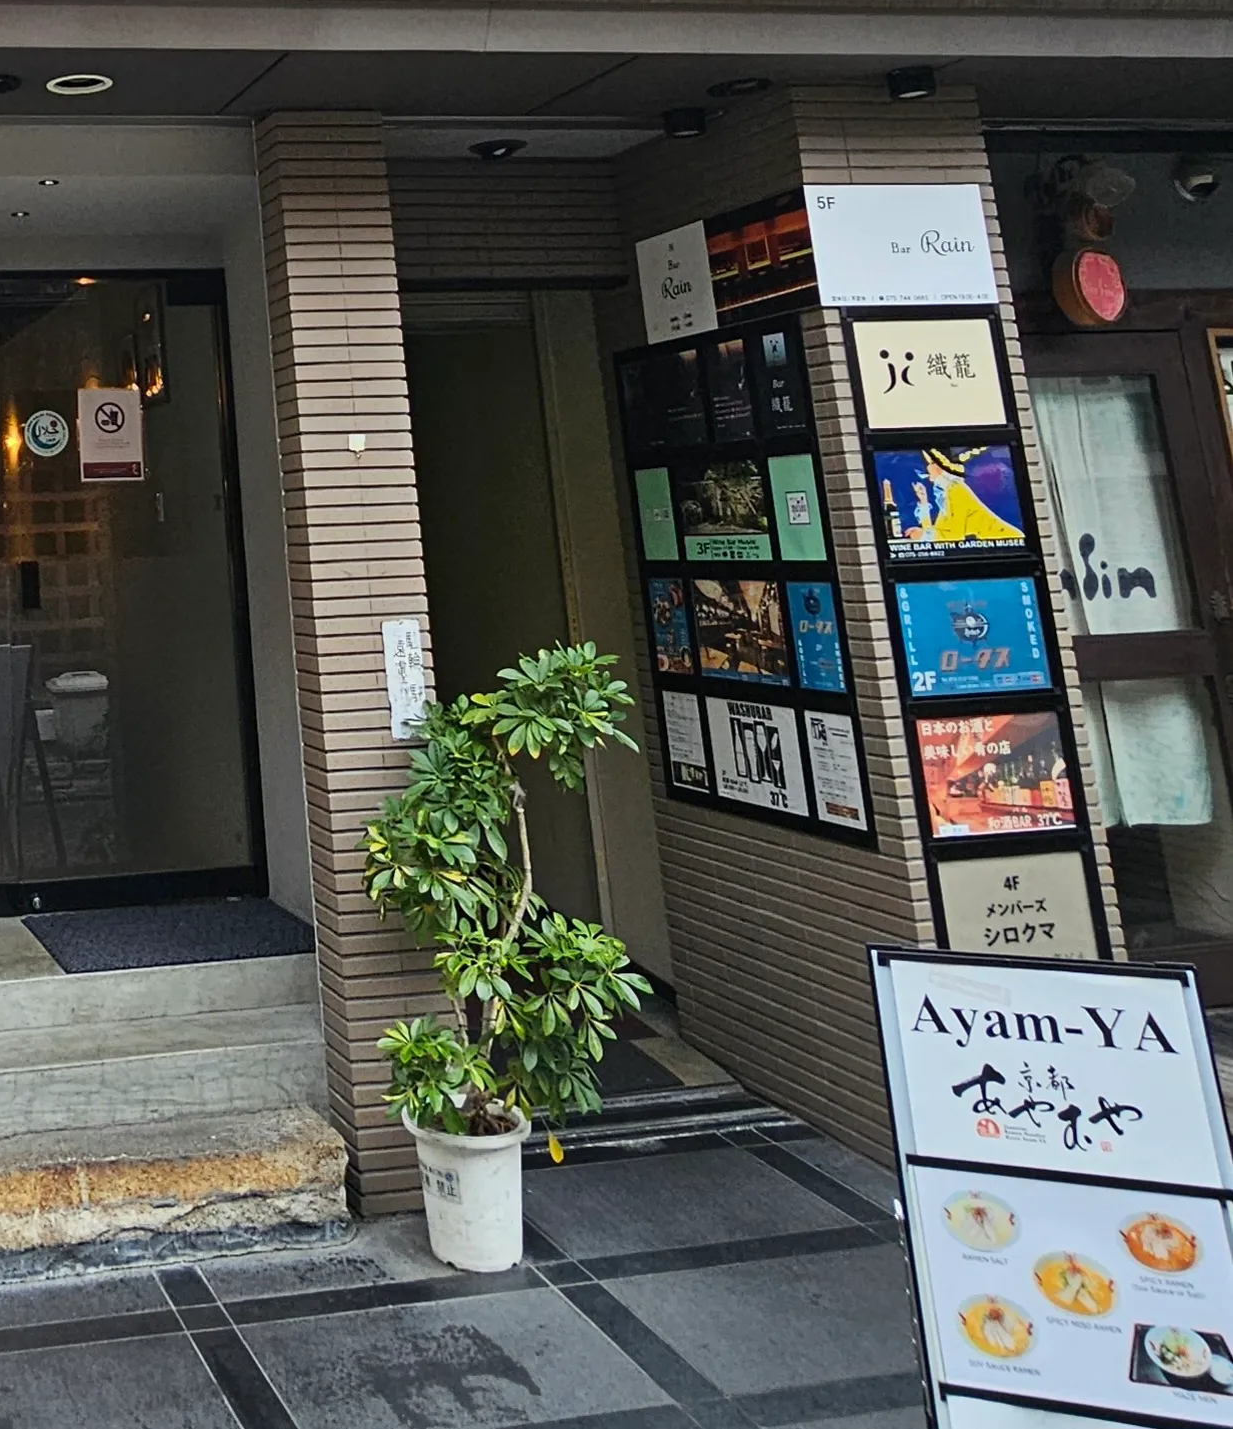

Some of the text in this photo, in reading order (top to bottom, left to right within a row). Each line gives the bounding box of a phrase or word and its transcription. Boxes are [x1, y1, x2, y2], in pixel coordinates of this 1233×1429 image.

[817, 196, 835, 209] 5F
[891, 229, 975, 256] Bar Rain
[661, 276, 693, 300] Rain
[696, 542, 711, 555] 3F
[889, 543, 912, 552] WINE
[913, 542, 932, 551] BAR
[934, 541, 956, 550] WITH
[958, 539, 995, 549] GARDEN
[1020, 581, 1041, 659] SMOKED
[940, 647, 1011, 673] ロータス
[912, 670, 937, 692] 2F
[921, 718, 995, 737] 日本のお酒と
[1003, 875, 1020, 891] 4F
[986, 897, 1048, 918] メンバーズ
[983, 922, 1056, 947] シロクマ
[911, 993, 1181, 1055] Ayam-YA
[1018, 1060, 1076, 1101] 京都
